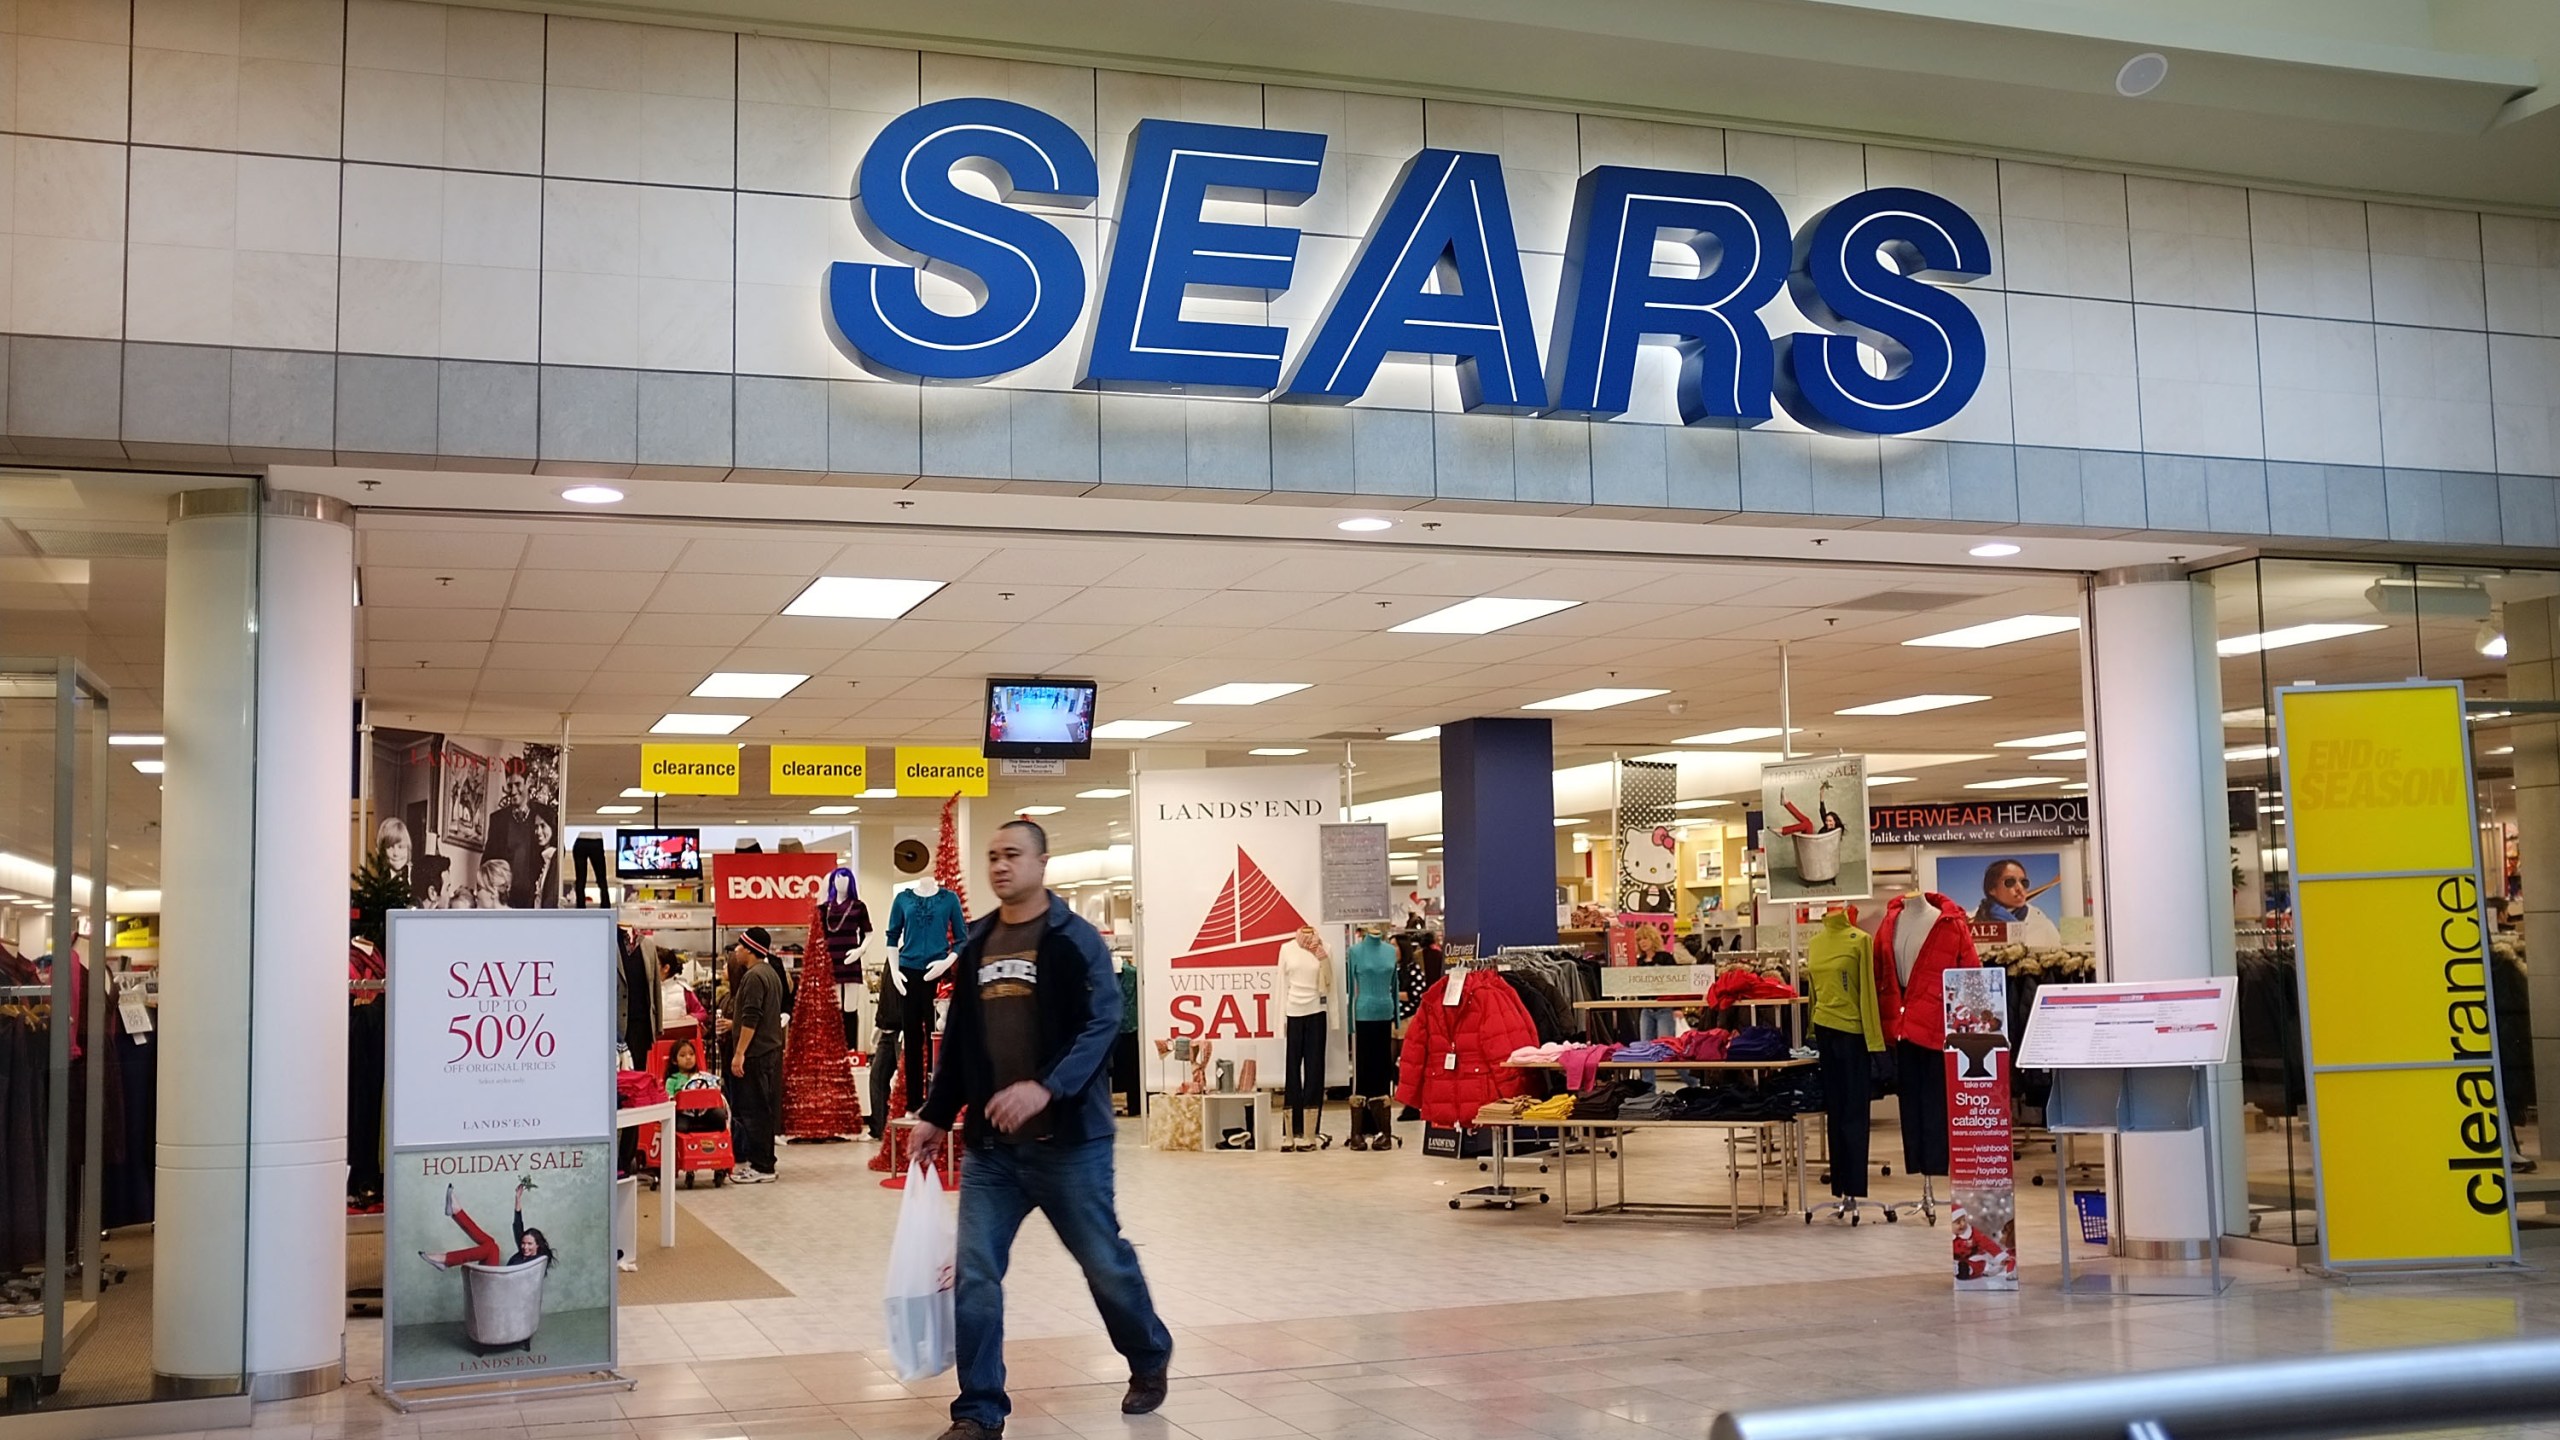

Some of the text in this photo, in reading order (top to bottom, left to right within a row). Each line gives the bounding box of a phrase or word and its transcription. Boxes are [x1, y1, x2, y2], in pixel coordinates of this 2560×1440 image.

[829, 97, 1993, 435] SEARS
[2307, 739, 2402, 771] END OF
[653, 759, 736, 776] clearance
[782, 761, 862, 778] clearance
[906, 763, 984, 779] clearance
[1826, 765, 1858, 778] SALE
[2299, 768, 2460, 811] SEASON
[1158, 798, 1323, 821] LANDS'END
[1870, 802, 2089, 830] UTERWEAR HEADQU
[1904, 830, 1920, 842] the
[1923, 829, 1966, 842] weather,
[1969, 828, 1995, 839] we're
[1999, 825, 2064, 839] Guaranteed.
[2068, 824, 2089, 836] Peri
[727, 875, 824, 900] BONGO
[1970, 923, 1999, 938] ALE
[447, 961, 557, 999] SAVE
[1169, 971, 1272, 991] WINTER'S
[1628, 974, 1688, 984] HOLIDAY SALE
[478, 999, 527, 1013] UP TO
[447, 1013, 556, 1064] 50%
[2437, 876, 2508, 1216] clearance
[444, 1061, 556, 1074] OFF ORIGINAL PRICES
[1964, 1081, 1979, 1089] take
[1955, 1092, 1990, 1108] Shop
[1969, 1107, 1978, 1115] all
[1979, 1107, 1987, 1115] of
[463, 1118, 541, 1130] LANDS'END
[1952, 1115, 2008, 1128] catalogs at
[422, 1150, 584, 1176] HOLIDAY SALE
[460, 1354, 547, 1372] LANDS'END
